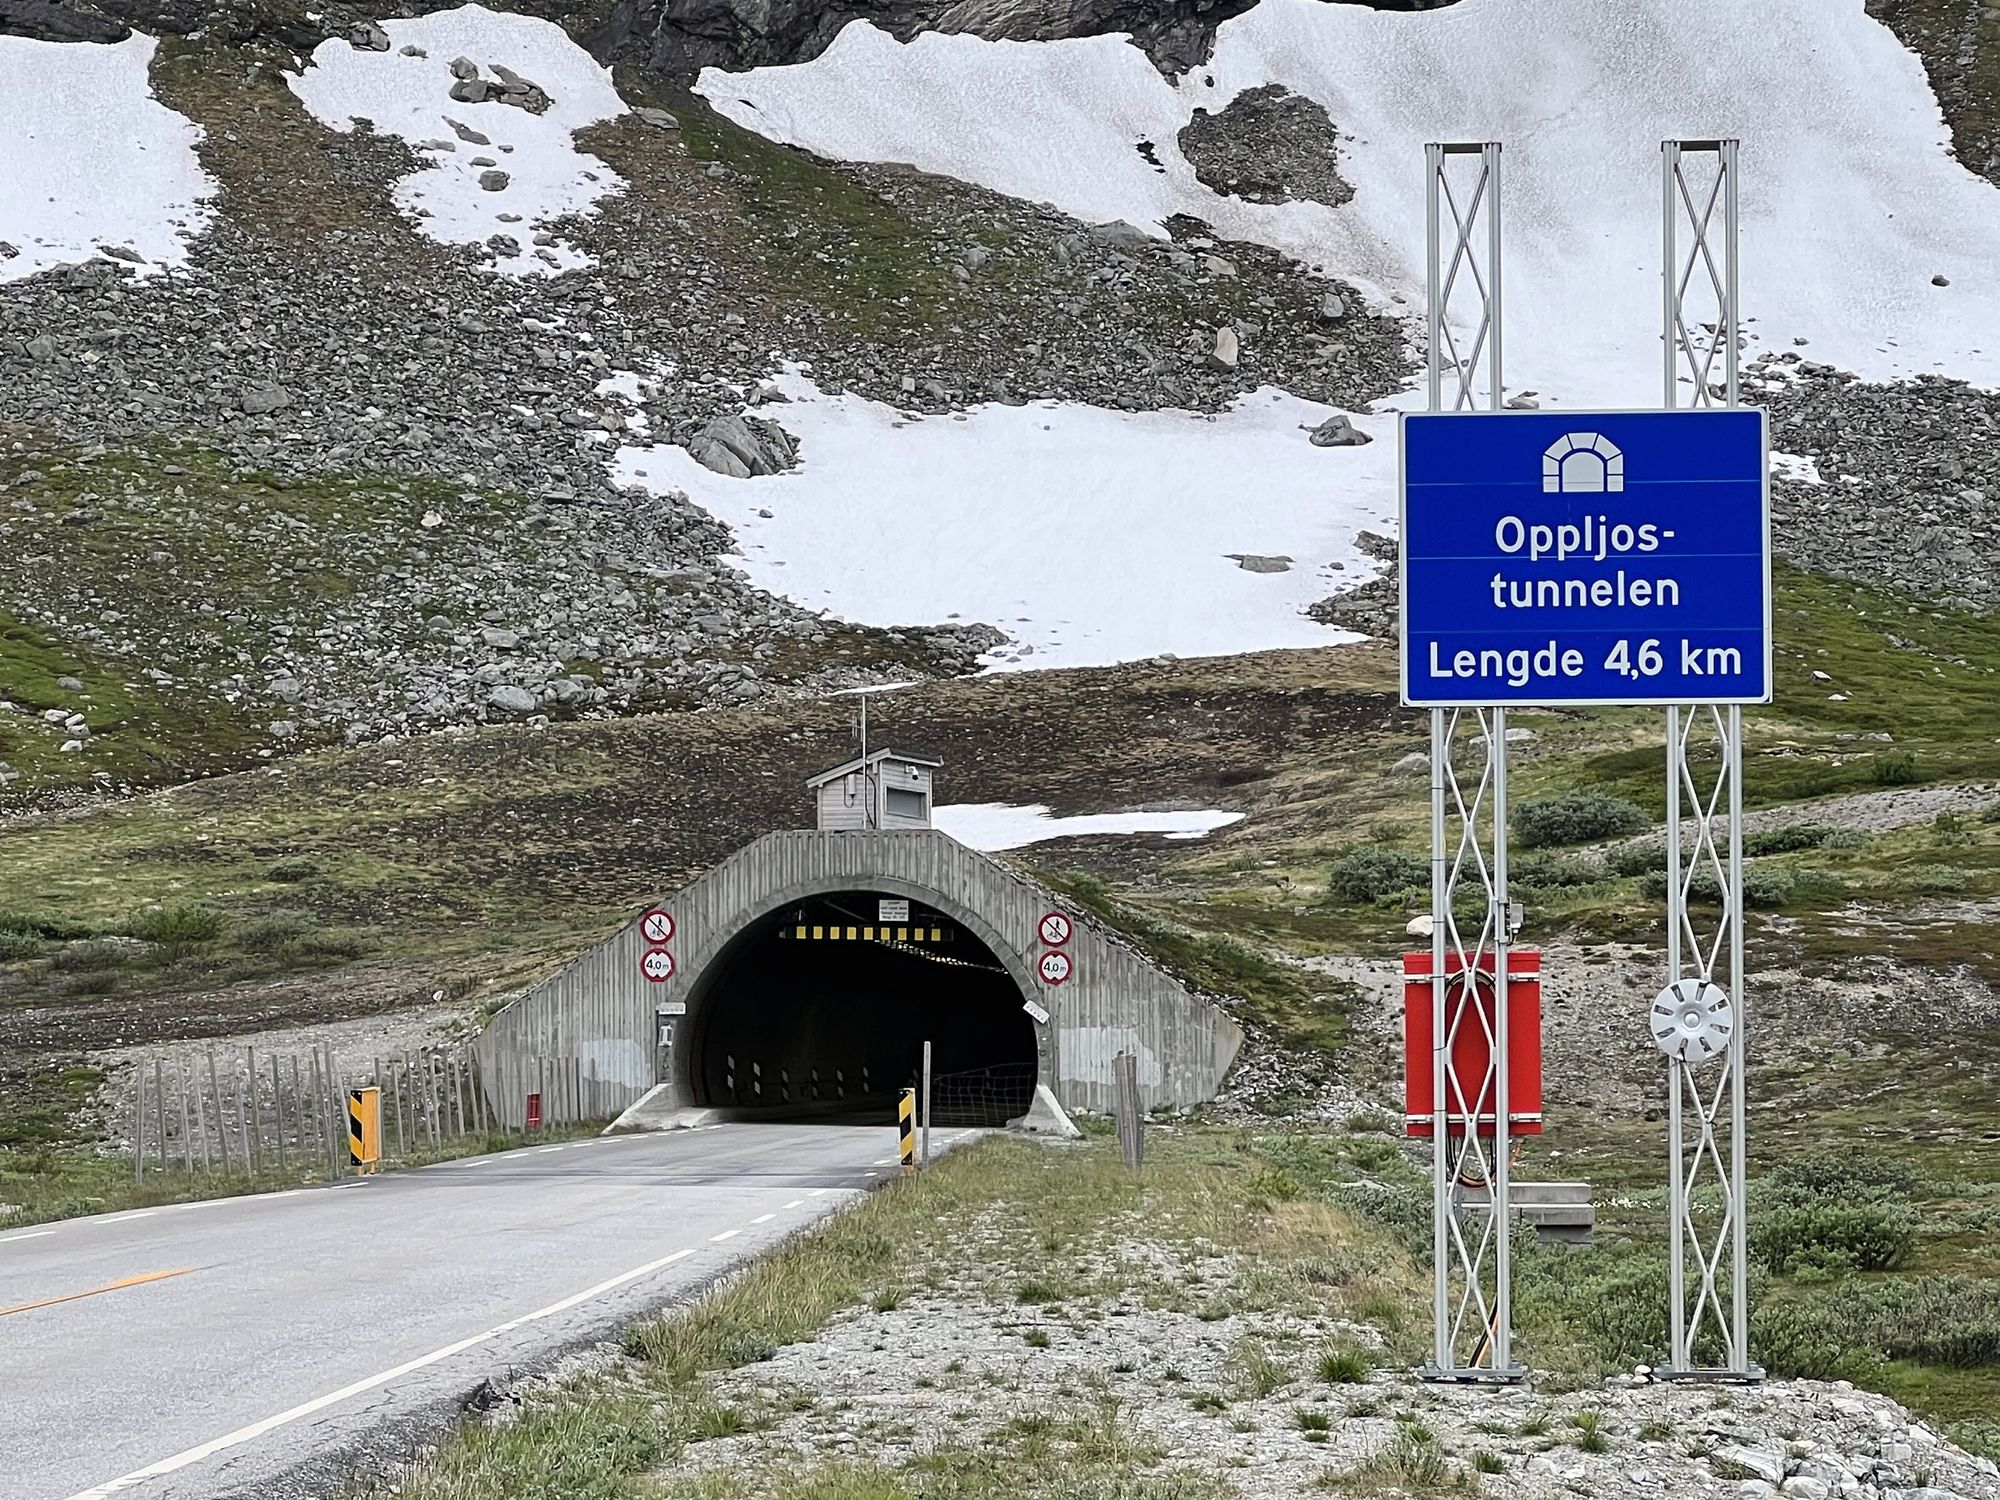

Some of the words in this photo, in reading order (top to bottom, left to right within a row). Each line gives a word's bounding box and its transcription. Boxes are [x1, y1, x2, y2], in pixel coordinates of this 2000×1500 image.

[1495, 515, 1675, 561] Oppljos-
[1490, 570, 1679, 608] tunnelen
[1430, 640, 1584, 687] Lengde
[1604, 639, 1663, 680] 4,6
[1681, 639, 1742, 676] km
